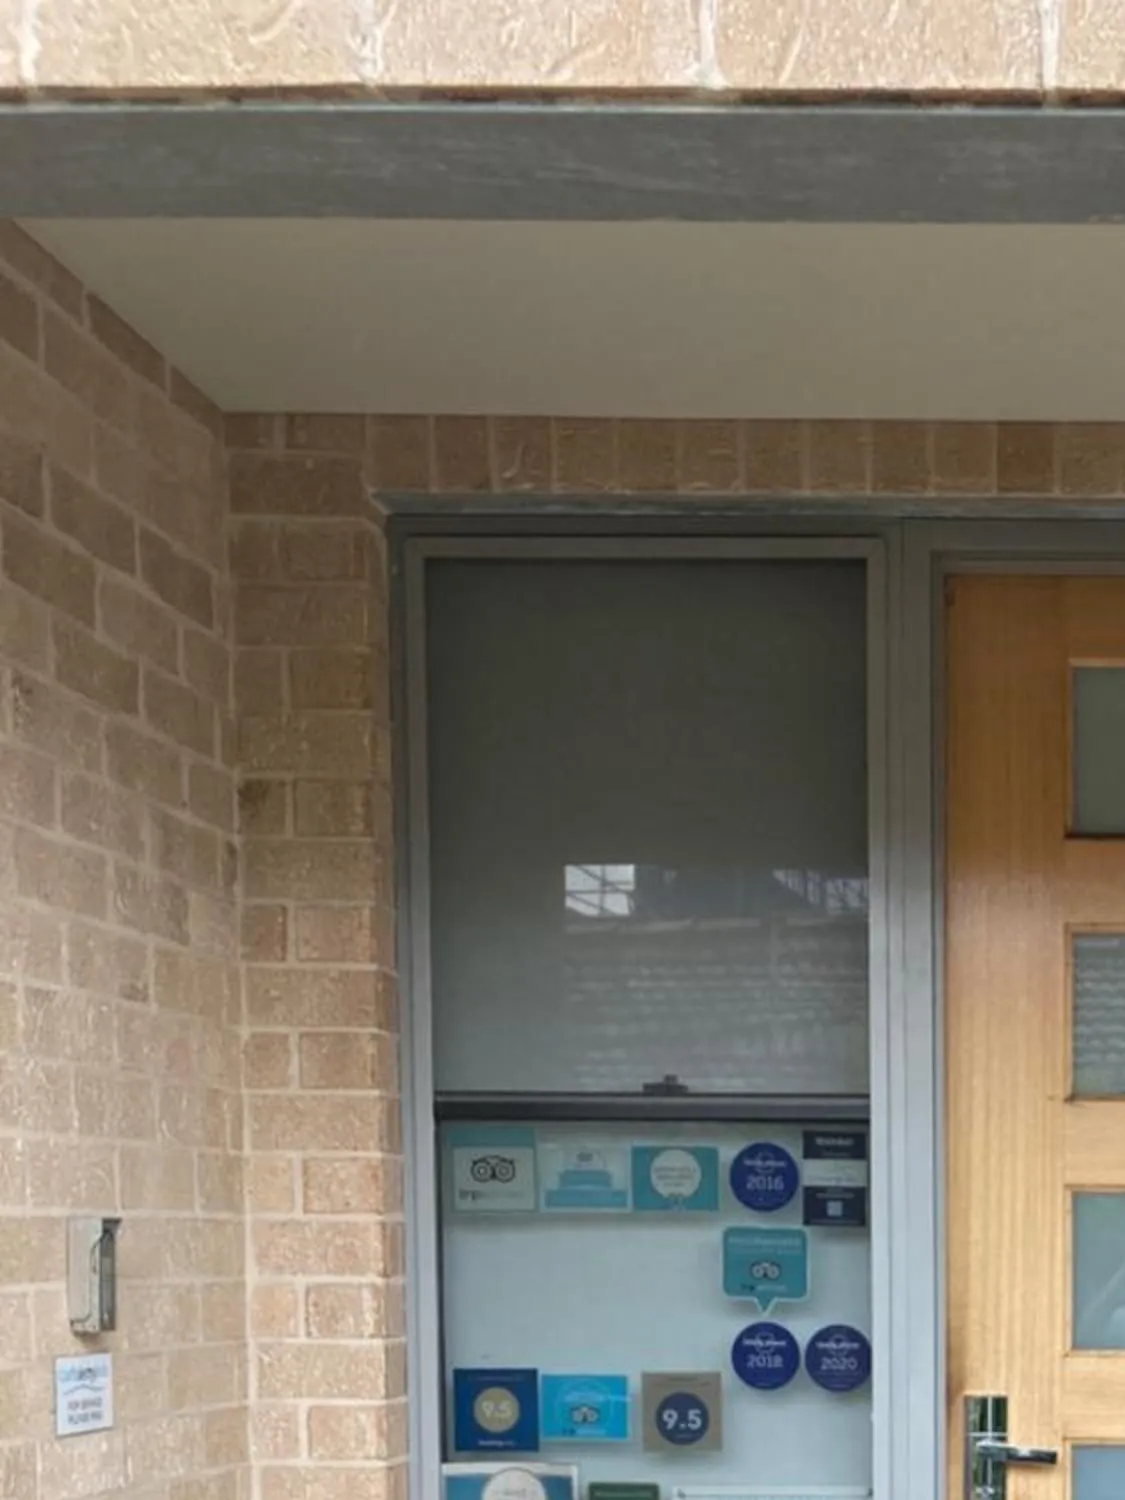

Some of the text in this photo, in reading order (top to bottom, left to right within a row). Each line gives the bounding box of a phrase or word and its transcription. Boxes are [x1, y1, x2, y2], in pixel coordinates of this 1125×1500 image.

[746, 1176, 785, 1191] 2016
[820, 1357, 858, 1370] 2020
[662, 1409, 702, 1430] 9.5
